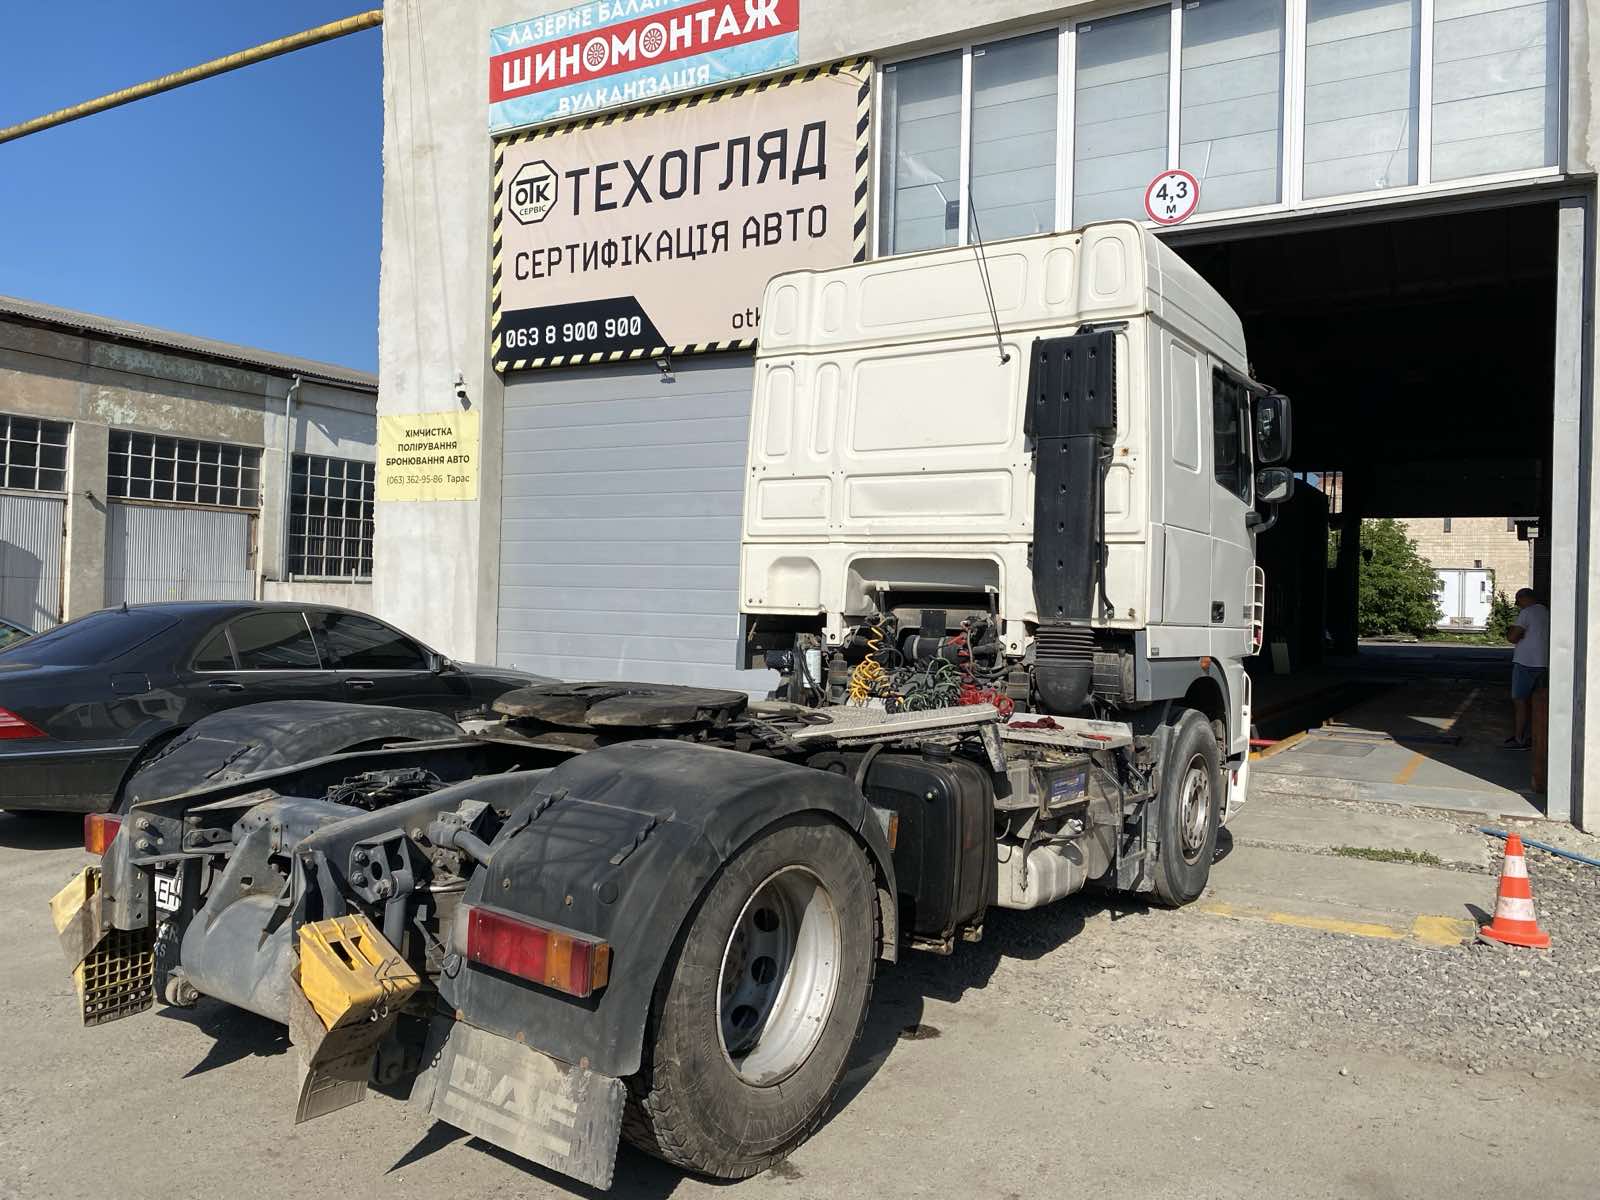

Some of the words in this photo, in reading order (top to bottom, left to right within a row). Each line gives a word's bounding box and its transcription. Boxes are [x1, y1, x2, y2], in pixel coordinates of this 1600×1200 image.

[507, 7, 592, 46] ЛАЗЕРНЕ
[502, 0, 782, 92] ШИНОМОНТАЖ
[558, 64, 711, 115] ВУЛКАНІЗАЦІЯ
[565, 120, 827, 216] ТЕХОГЛЯД
[1156, 181, 1188, 203] 4,3
[520, 204, 547, 216] СЕРВІС
[515, 220, 729, 281] СЕРТИФІКАЦІЯ
[742, 204, 828, 249] АВТО
[505, 327, 539, 348] 063
[545, 325, 556, 344] 8
[563, 320, 598, 342] 900
[605, 316, 641, 338] 900
[405, 427, 453, 438] ХІМЧИСТКА
[397, 441, 457, 452] ПОЛІРУВАННЯ
[386, 456, 445, 466] БРОНЮВАННЯ
[446, 455, 470, 464] АВТО
[386, 475, 405, 485] (063)
[406, 475, 443, 485] 362-95-86
[447, 474, 470, 484] Тарас
